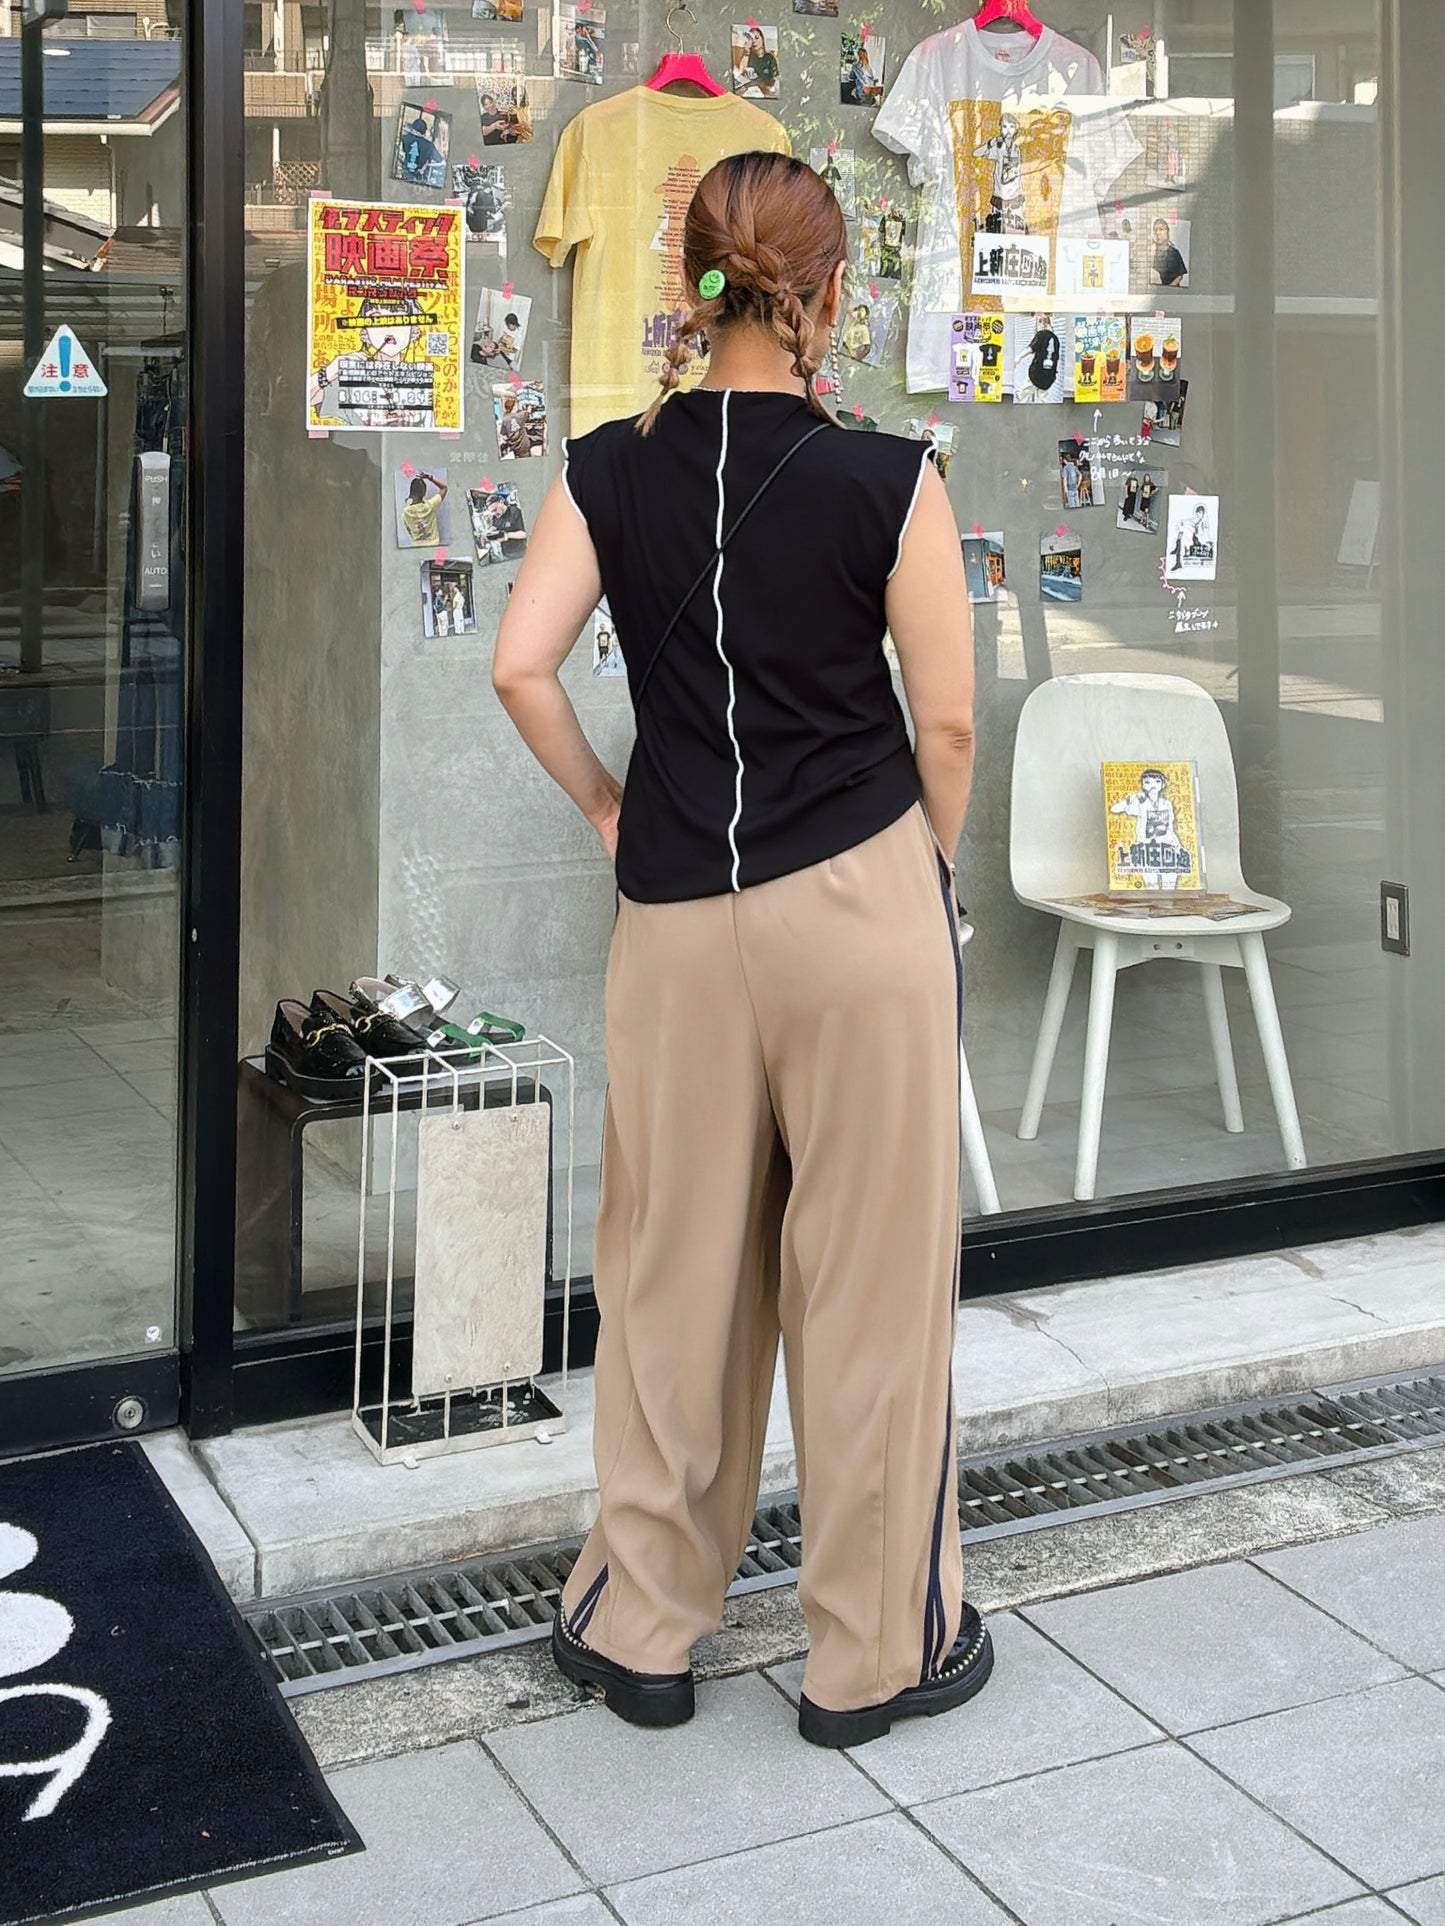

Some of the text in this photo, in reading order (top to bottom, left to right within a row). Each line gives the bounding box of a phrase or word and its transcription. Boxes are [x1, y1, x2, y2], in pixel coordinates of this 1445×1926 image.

[325, 232, 449, 278] 映画祭
[41, 363, 89, 378] 注 意
[144, 475, 168, 483] PUSH
[144, 567, 168, 575] AUTO
